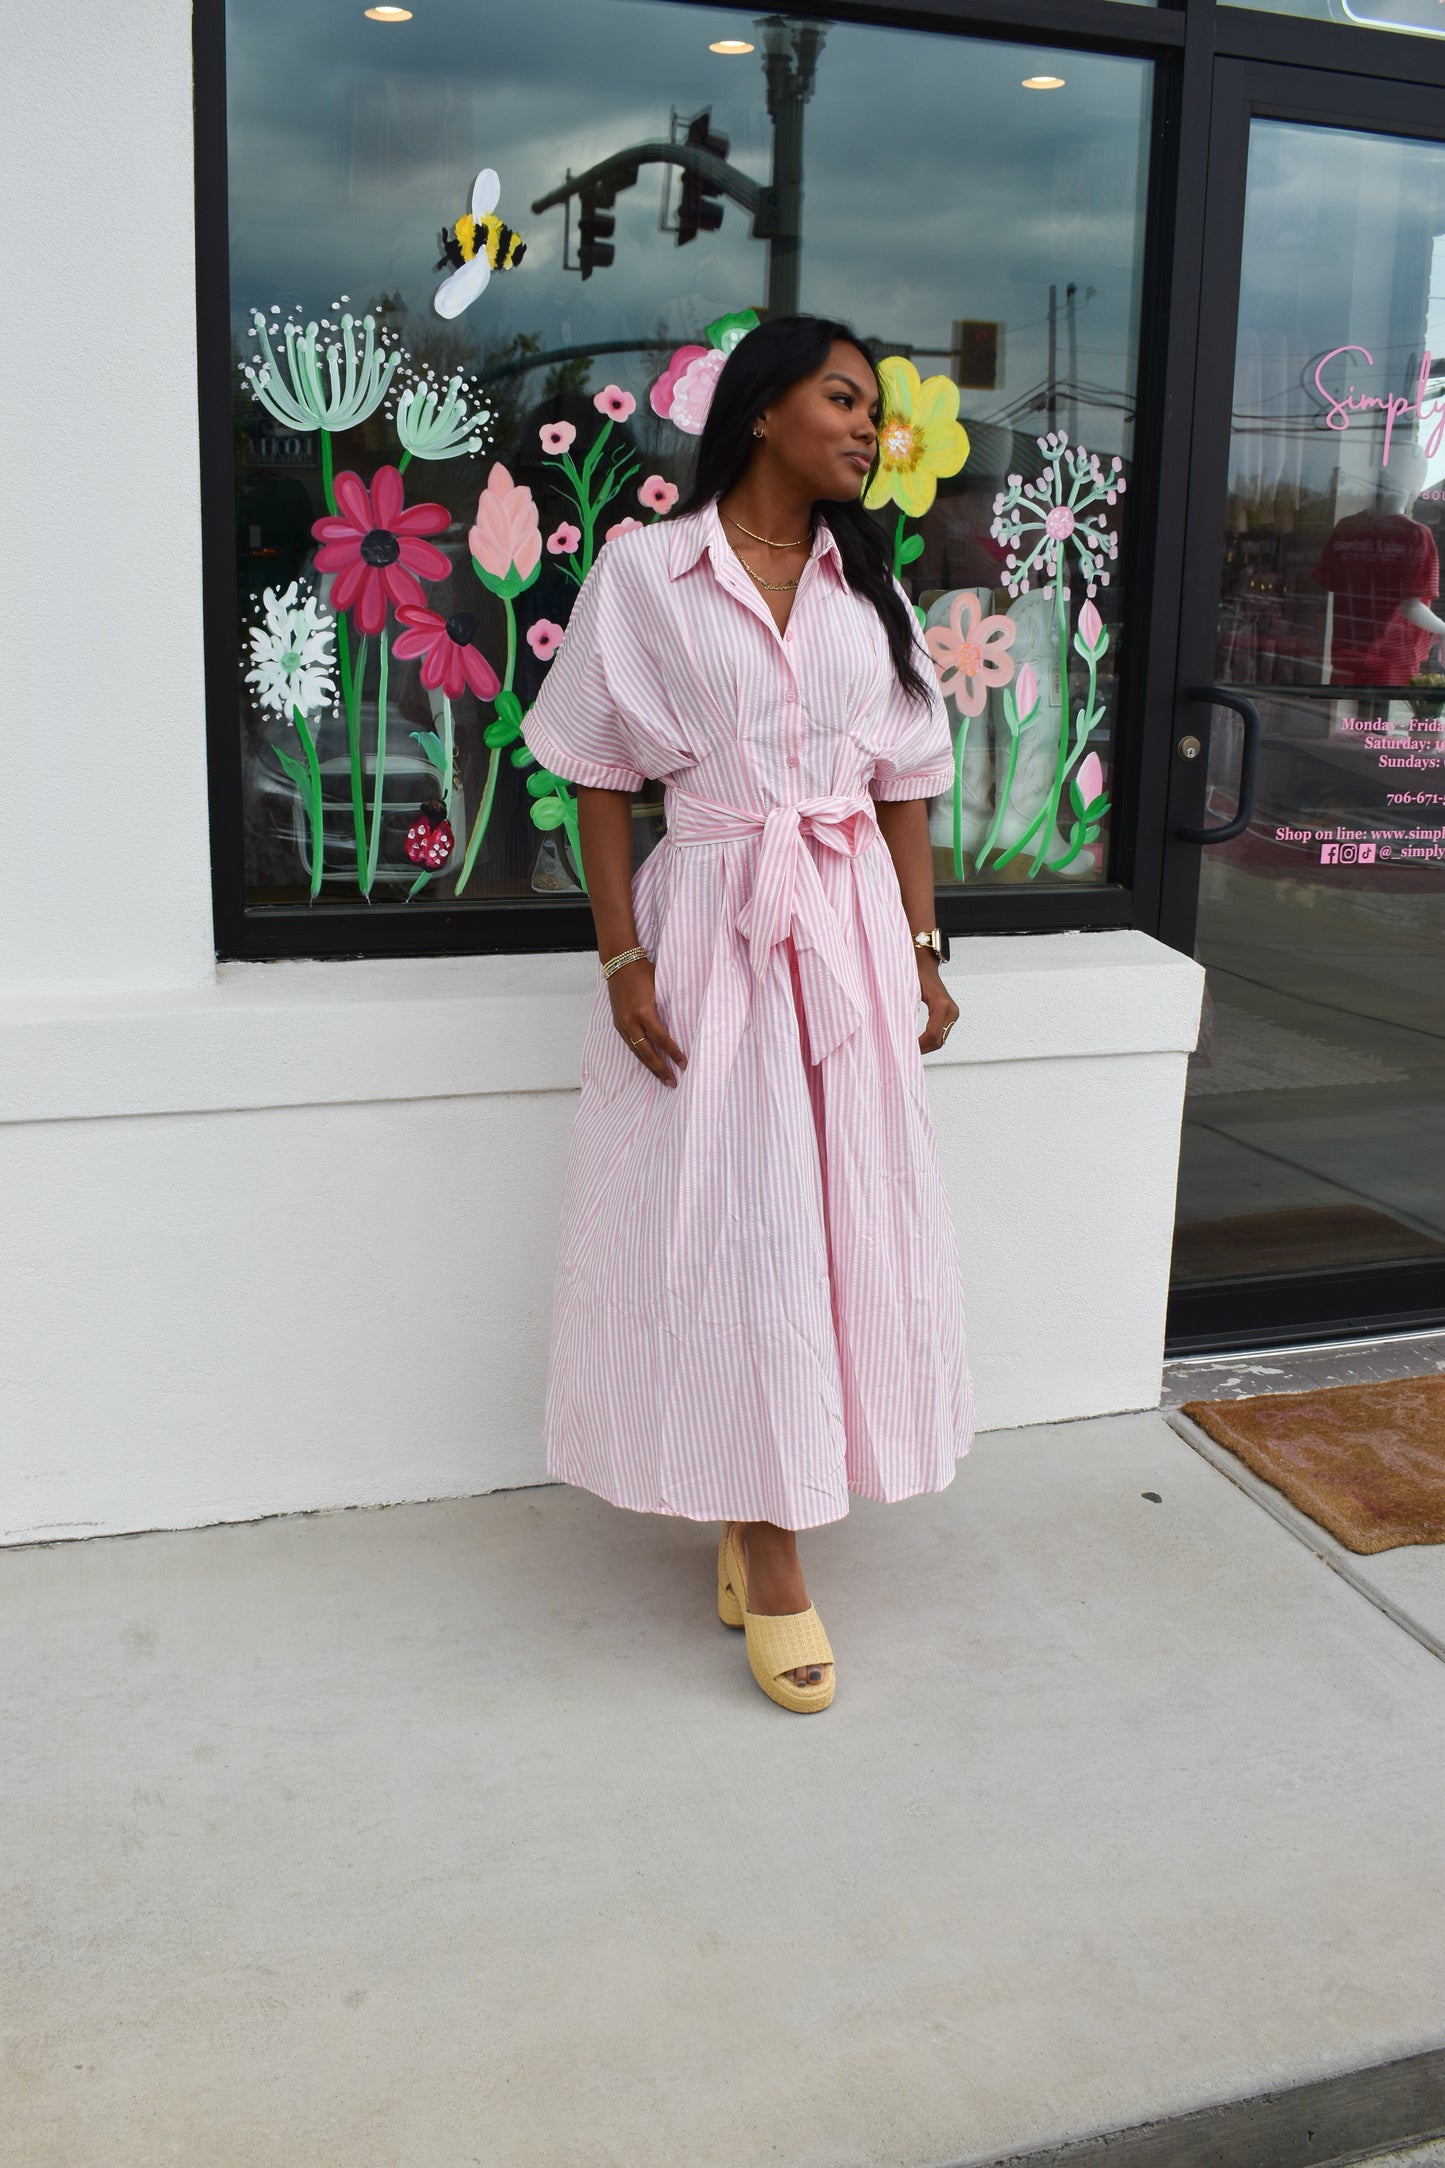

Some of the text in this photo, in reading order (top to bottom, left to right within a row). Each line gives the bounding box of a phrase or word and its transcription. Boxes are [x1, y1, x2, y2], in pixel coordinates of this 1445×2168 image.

[1341, 717, 1396, 734] Monday
[1364, 736, 1431, 752] Saturday:
[1379, 755, 1440, 771] Sundays:
[1275, 826, 1312, 844] Shop
[1315, 830, 1333, 840] on
[1336, 826, 1367, 840] line:
